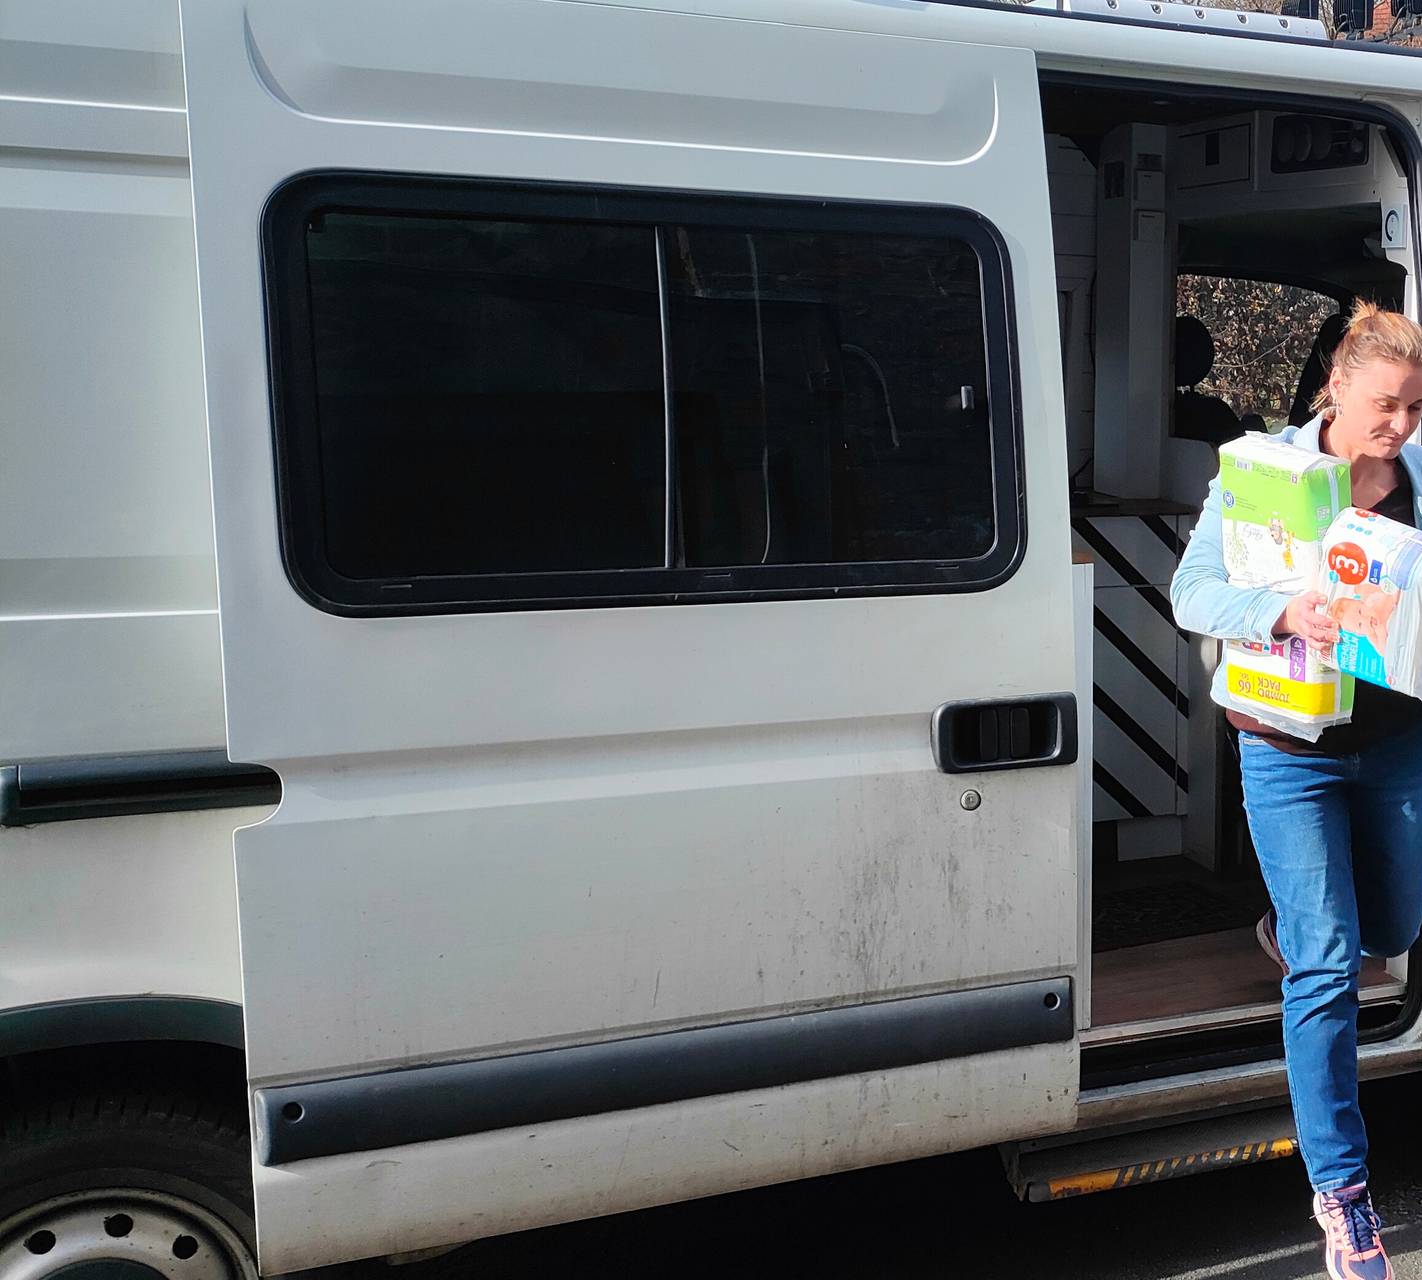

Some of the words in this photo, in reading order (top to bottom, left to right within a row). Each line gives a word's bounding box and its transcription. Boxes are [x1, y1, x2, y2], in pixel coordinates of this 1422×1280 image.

[1335, 554, 1359, 575] 3
[1238, 679, 1252, 694] 66
[1257, 676, 1281, 691] PACK
